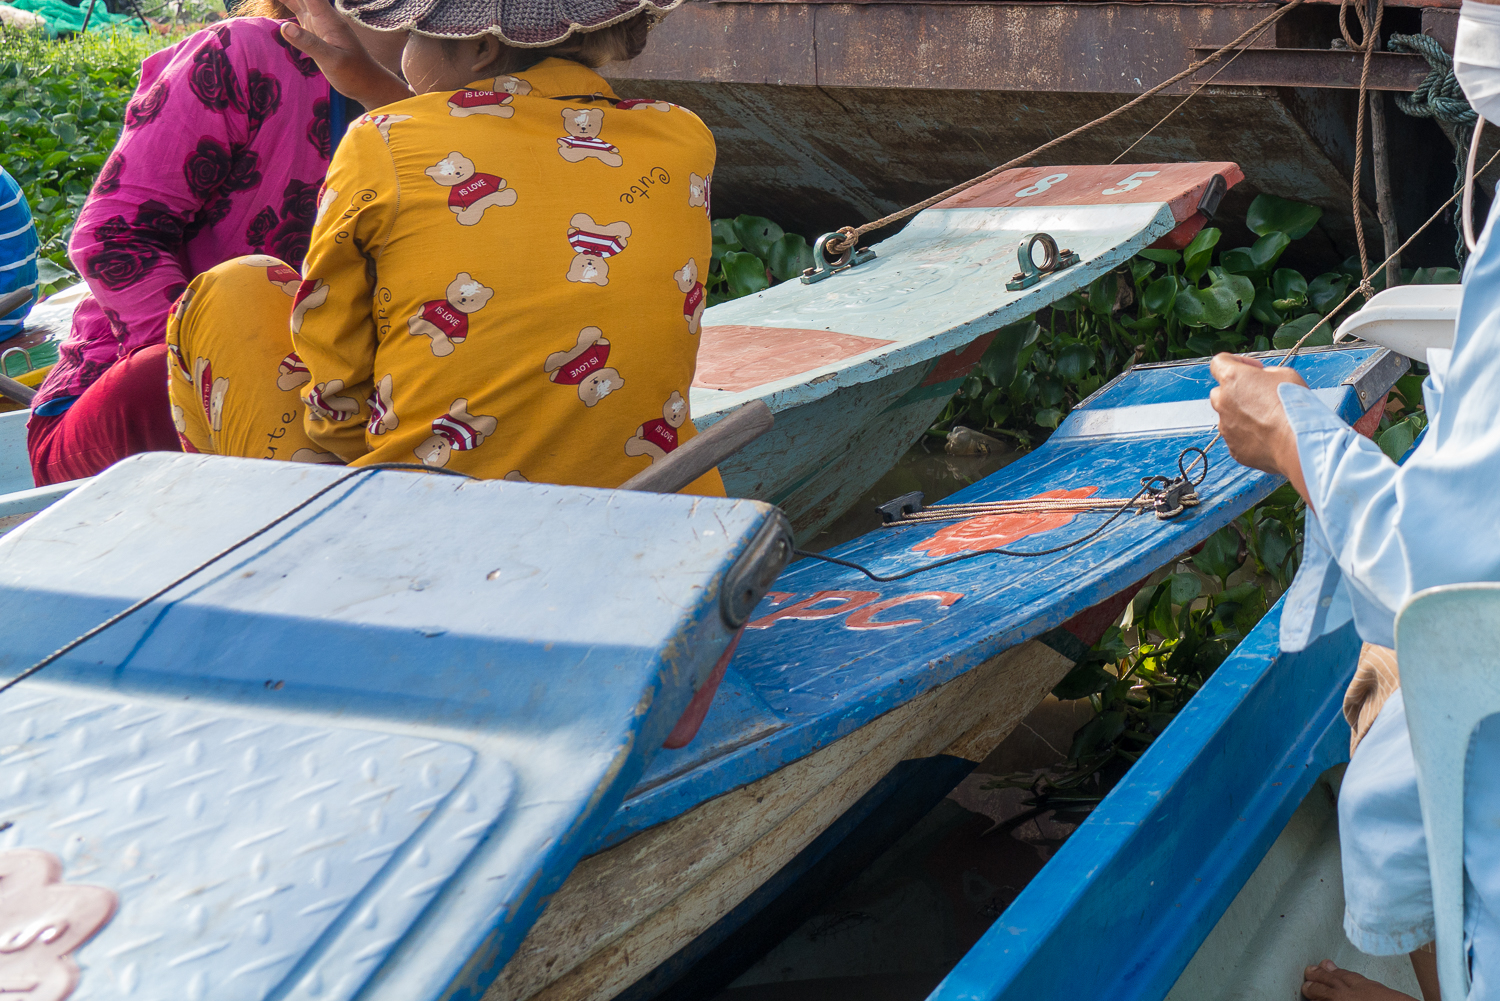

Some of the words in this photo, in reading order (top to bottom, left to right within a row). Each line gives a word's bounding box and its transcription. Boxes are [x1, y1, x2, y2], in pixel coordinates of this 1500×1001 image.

[459, 187, 468, 196] IS
[468, 179, 487, 192] LOVE
[620, 166, 671, 205] Cute
[378, 287, 391, 335] Cut
[434, 306, 442, 315] IS
[442, 311, 461, 327] LOVE
[570, 361, 590, 378] LOVE
[591, 356, 599, 366] IS
[661, 428, 674, 442] LOVE
